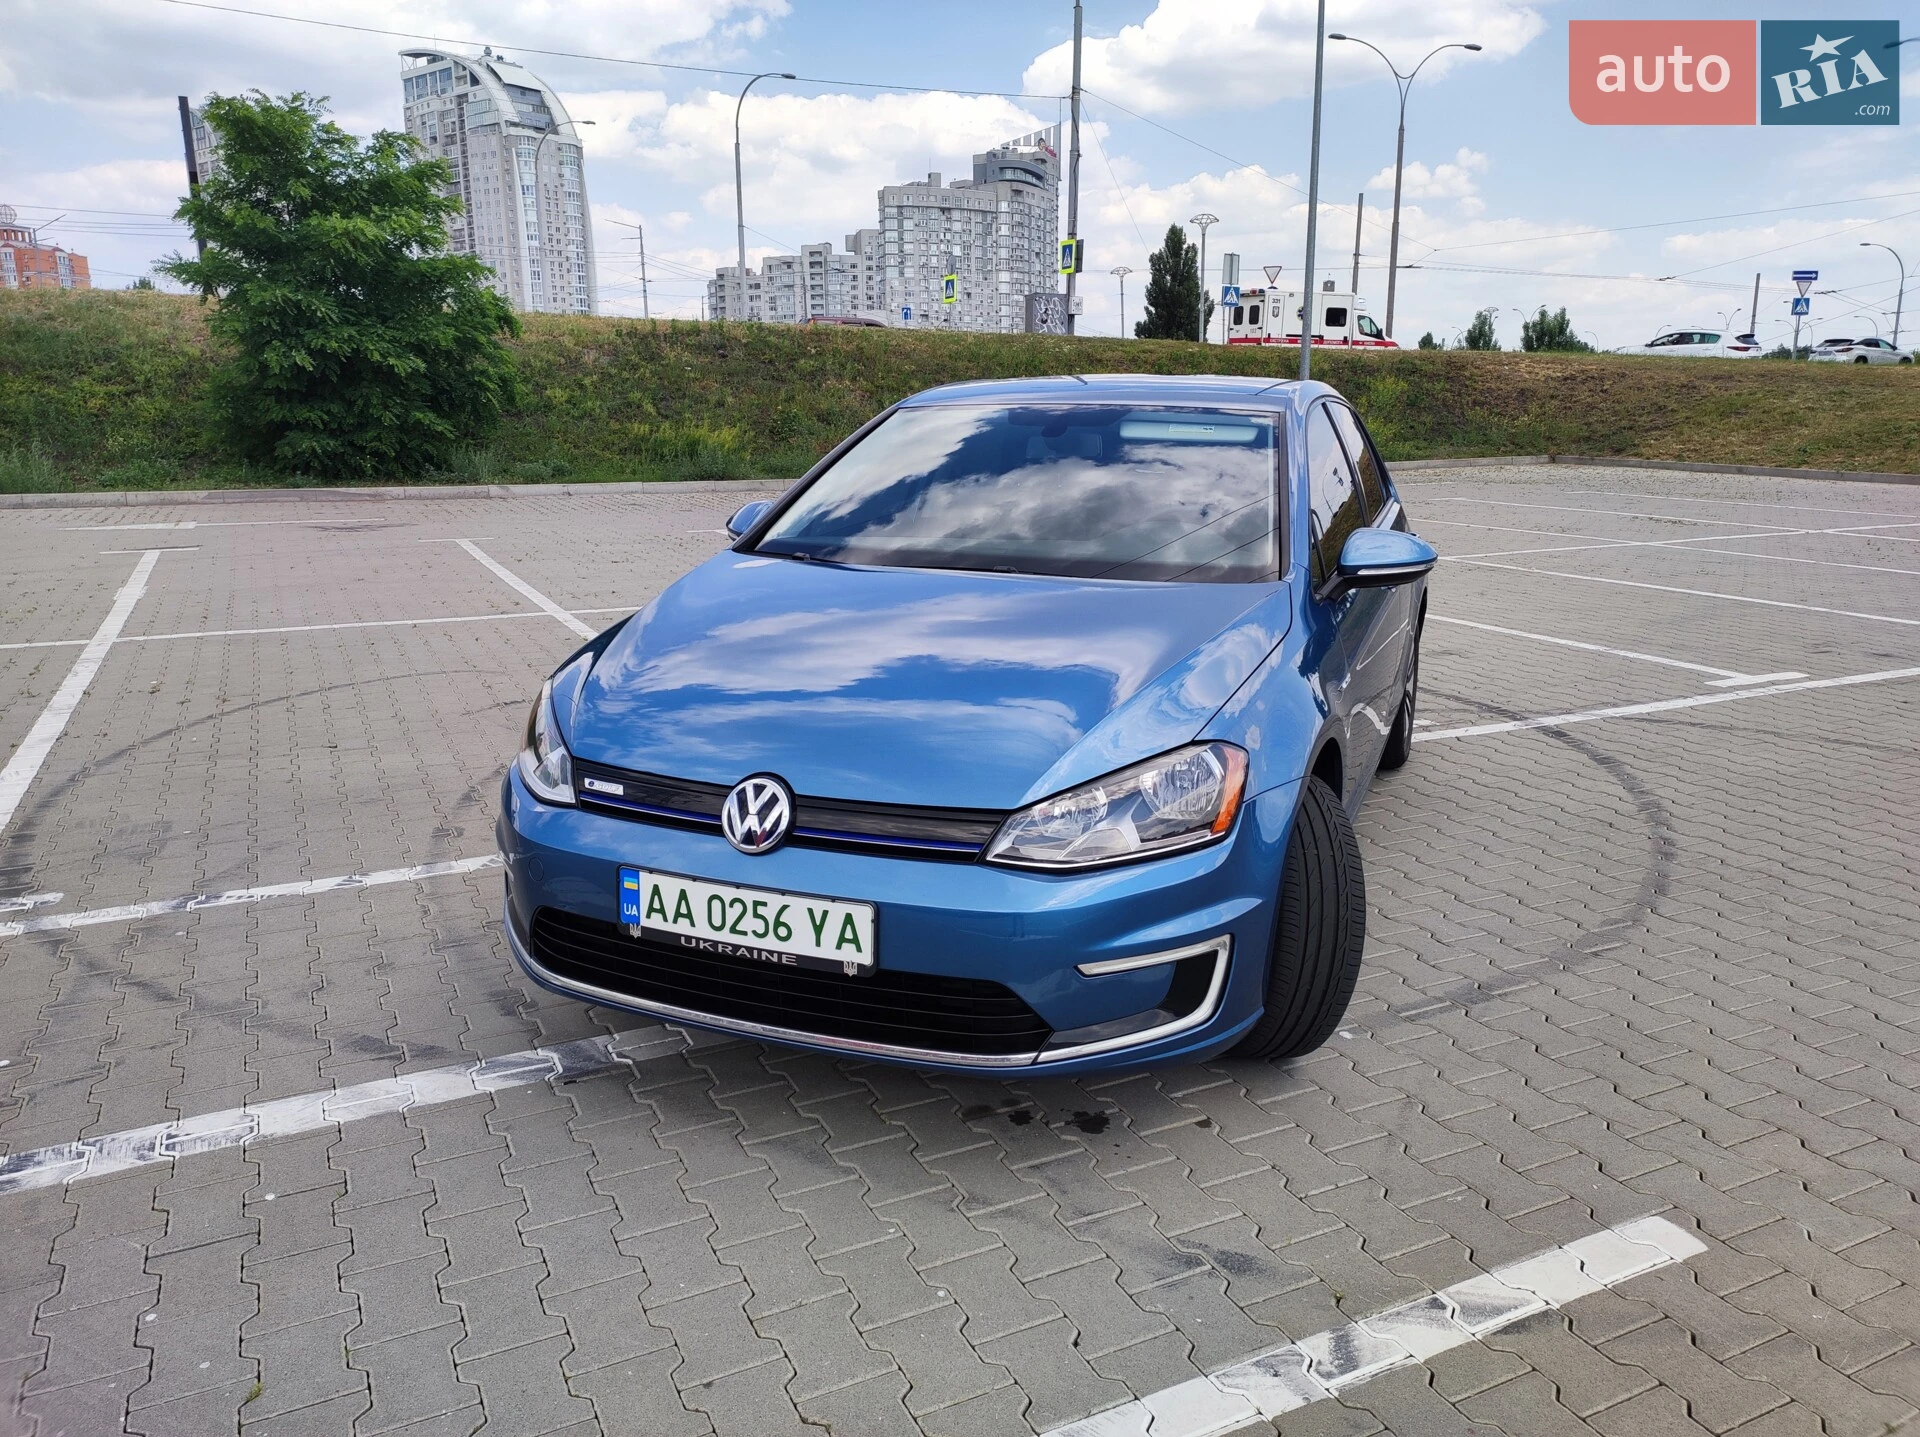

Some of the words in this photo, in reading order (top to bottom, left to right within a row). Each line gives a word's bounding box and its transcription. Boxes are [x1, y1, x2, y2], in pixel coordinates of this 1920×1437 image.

[623, 902, 639, 917] UA
[645, 883, 696, 928] AA
[706, 893, 793, 942] 0256
[807, 907, 863, 953] YA
[680, 936, 798, 966] UKRAINE
